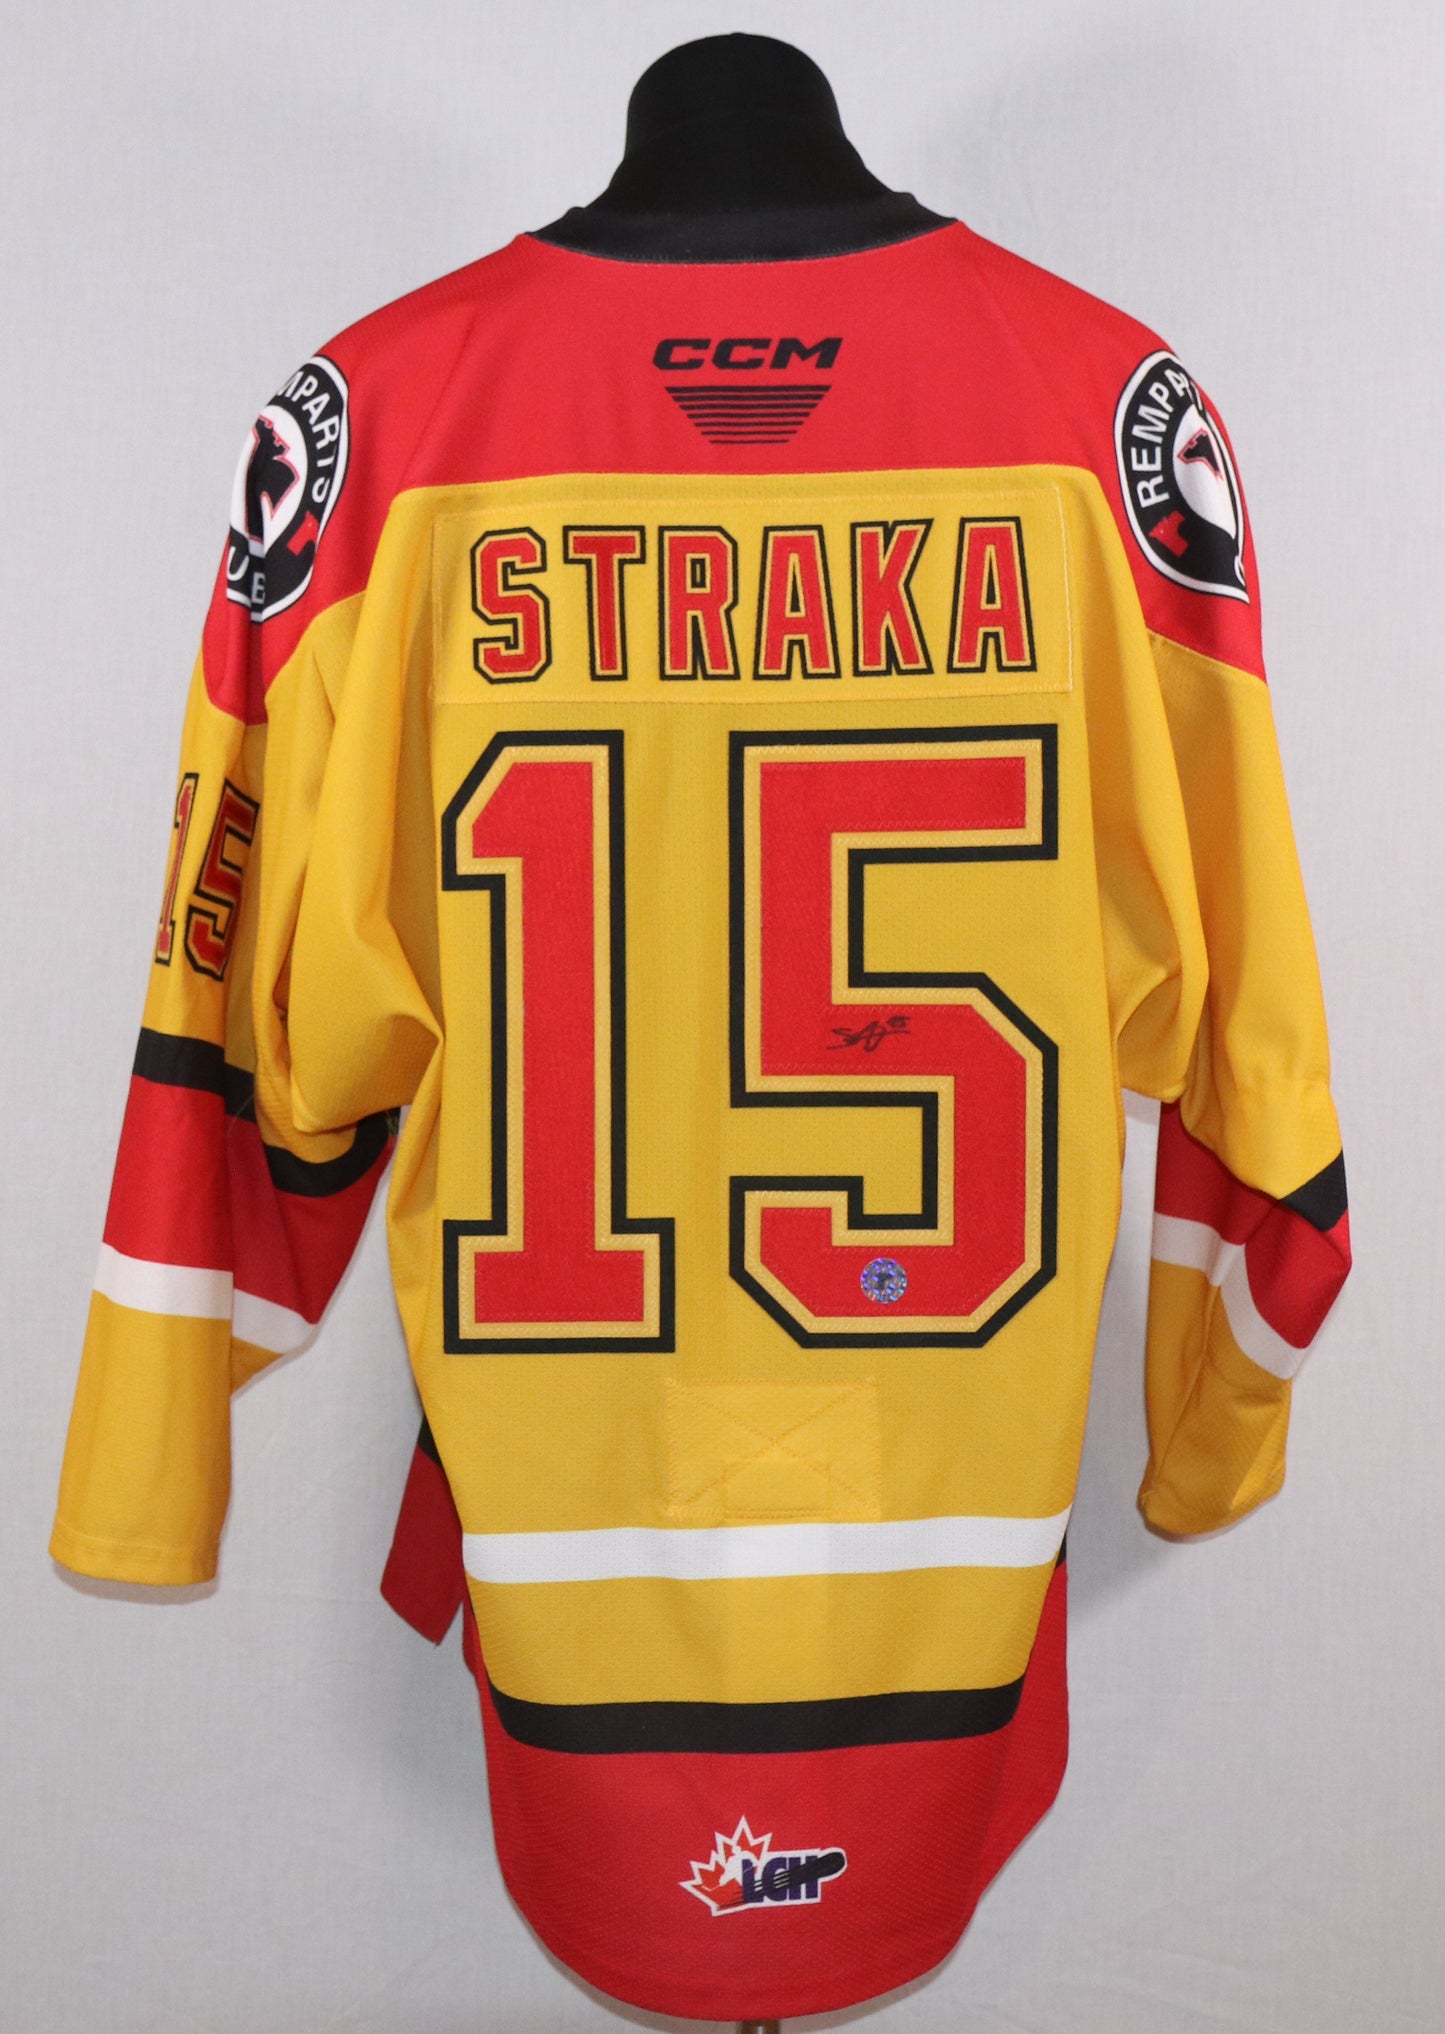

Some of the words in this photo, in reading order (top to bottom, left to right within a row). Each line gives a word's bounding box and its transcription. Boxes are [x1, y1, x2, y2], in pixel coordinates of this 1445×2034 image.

[653, 338, 843, 370] CCM
[1131, 368, 1192, 508] REMPA
[471, 517, 1037, 683] STRAKA
[155, 773, 260, 982] 15
[442, 724, 1058, 1353] 15
